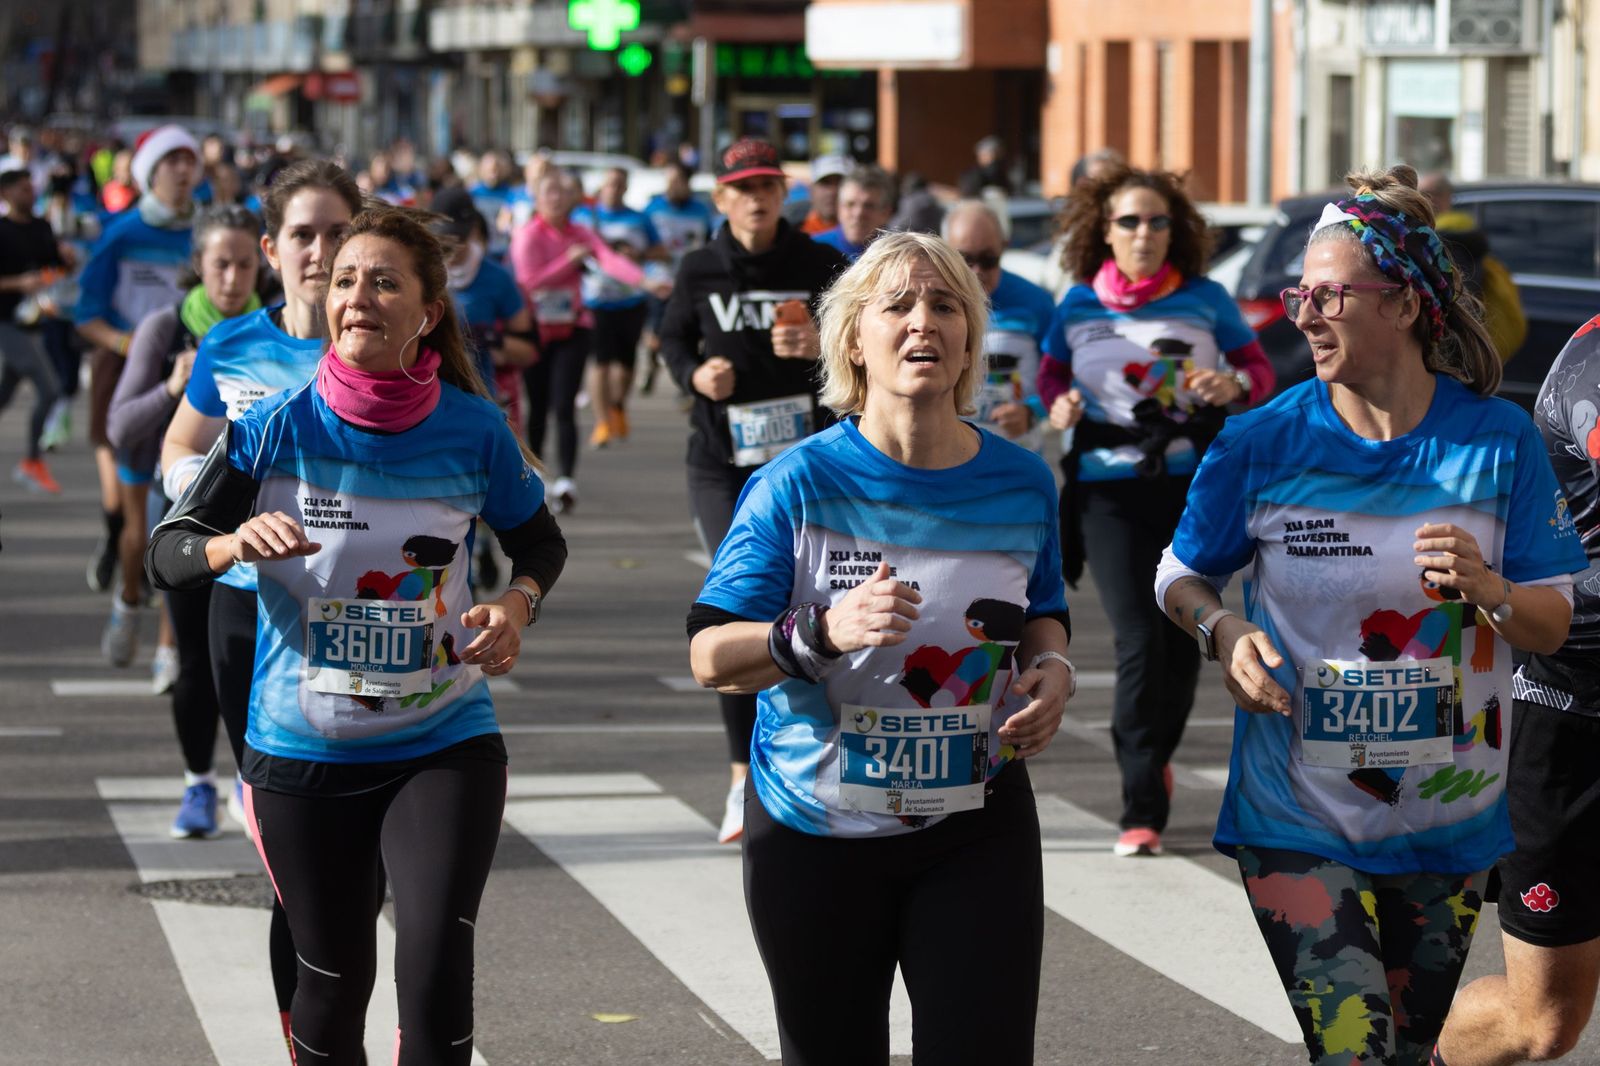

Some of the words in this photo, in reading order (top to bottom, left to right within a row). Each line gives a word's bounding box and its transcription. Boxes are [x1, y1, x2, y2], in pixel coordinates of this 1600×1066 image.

[742, 415, 797, 446] 6008
[304, 498, 318, 507] XLI
[320, 499, 342, 508] SAN
[304, 508, 352, 519] SILVESTRE
[304, 519, 369, 531] SALMANTINA
[1284, 520, 1304, 533] XLI
[1306, 519, 1334, 530] SAN
[1283, 532, 1350, 544] SILVESTRE
[829, 551, 850, 562] XLI
[854, 551, 882, 562] SAN
[1286, 545, 1374, 557] SALMANTINA
[345, 605, 426, 623] SETEL
[326, 623, 412, 666] 3600
[351, 662, 384, 673] MONICA
[1343, 667, 1440, 686] SETEL
[1323, 690, 1418, 733] 3402
[880, 714, 977, 733] SETEL
[1348, 733, 1393, 742] REICHEL
[865, 737, 950, 780] 3401
[1368, 751, 1410, 759] Ayuntamiento
[904, 797, 945, 806] Ayuntamiento
[913, 805, 944, 813] Salamanca
